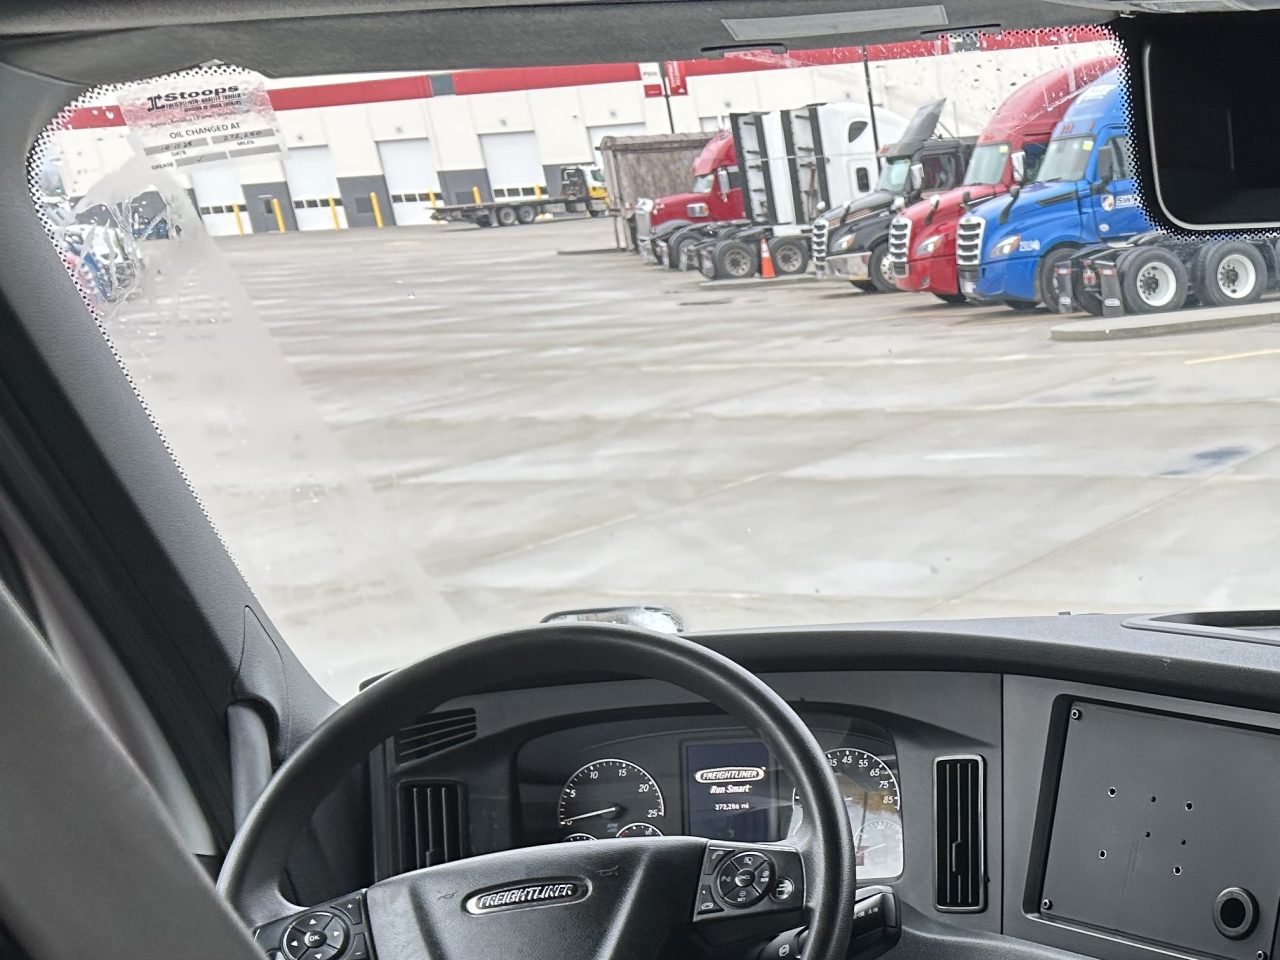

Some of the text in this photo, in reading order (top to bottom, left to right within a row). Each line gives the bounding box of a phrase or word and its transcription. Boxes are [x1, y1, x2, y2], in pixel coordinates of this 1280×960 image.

[164, 85, 239, 103] Stoops
[169, 122, 241, 139] OIL CHANGED AT
[841, 755, 852, 764] 45
[858, 760, 868, 768] 55
[590, 771, 599, 779] 10
[618, 768, 627, 777] 15
[702, 770, 758, 780] FREIGHTLINER
[869, 769, 880, 777] 65
[638, 784, 649, 793] 20
[710, 784, 750, 794] Run Smart
[879, 780, 889, 789] 75
[570, 789, 576, 798] 5
[883, 795, 893, 804] 85
[647, 809, 658, 818] 25
[478, 884, 574, 908] FREIGHTLINER
[309, 934, 320, 942] OK
